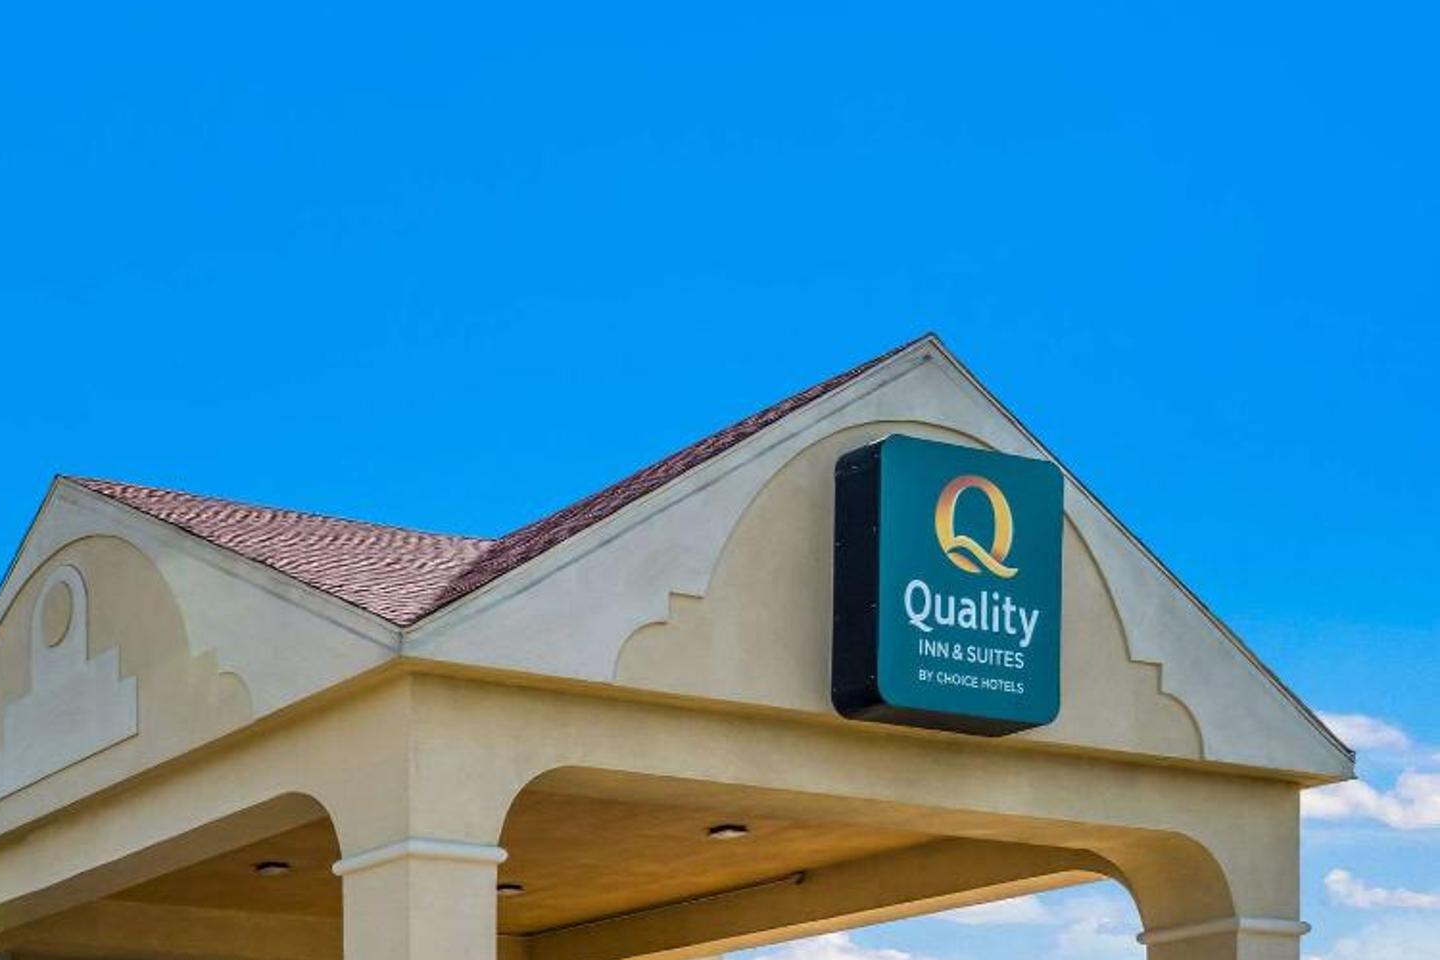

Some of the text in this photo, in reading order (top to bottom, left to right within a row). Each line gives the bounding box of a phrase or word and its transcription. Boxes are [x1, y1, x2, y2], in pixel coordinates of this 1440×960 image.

[935, 475, 1019, 579] Q
[904, 579, 1040, 648] Quality
[918, 639, 1025, 669] INN & SUITES
[918, 669, 1025, 694] BY CHOICE HOTELS
